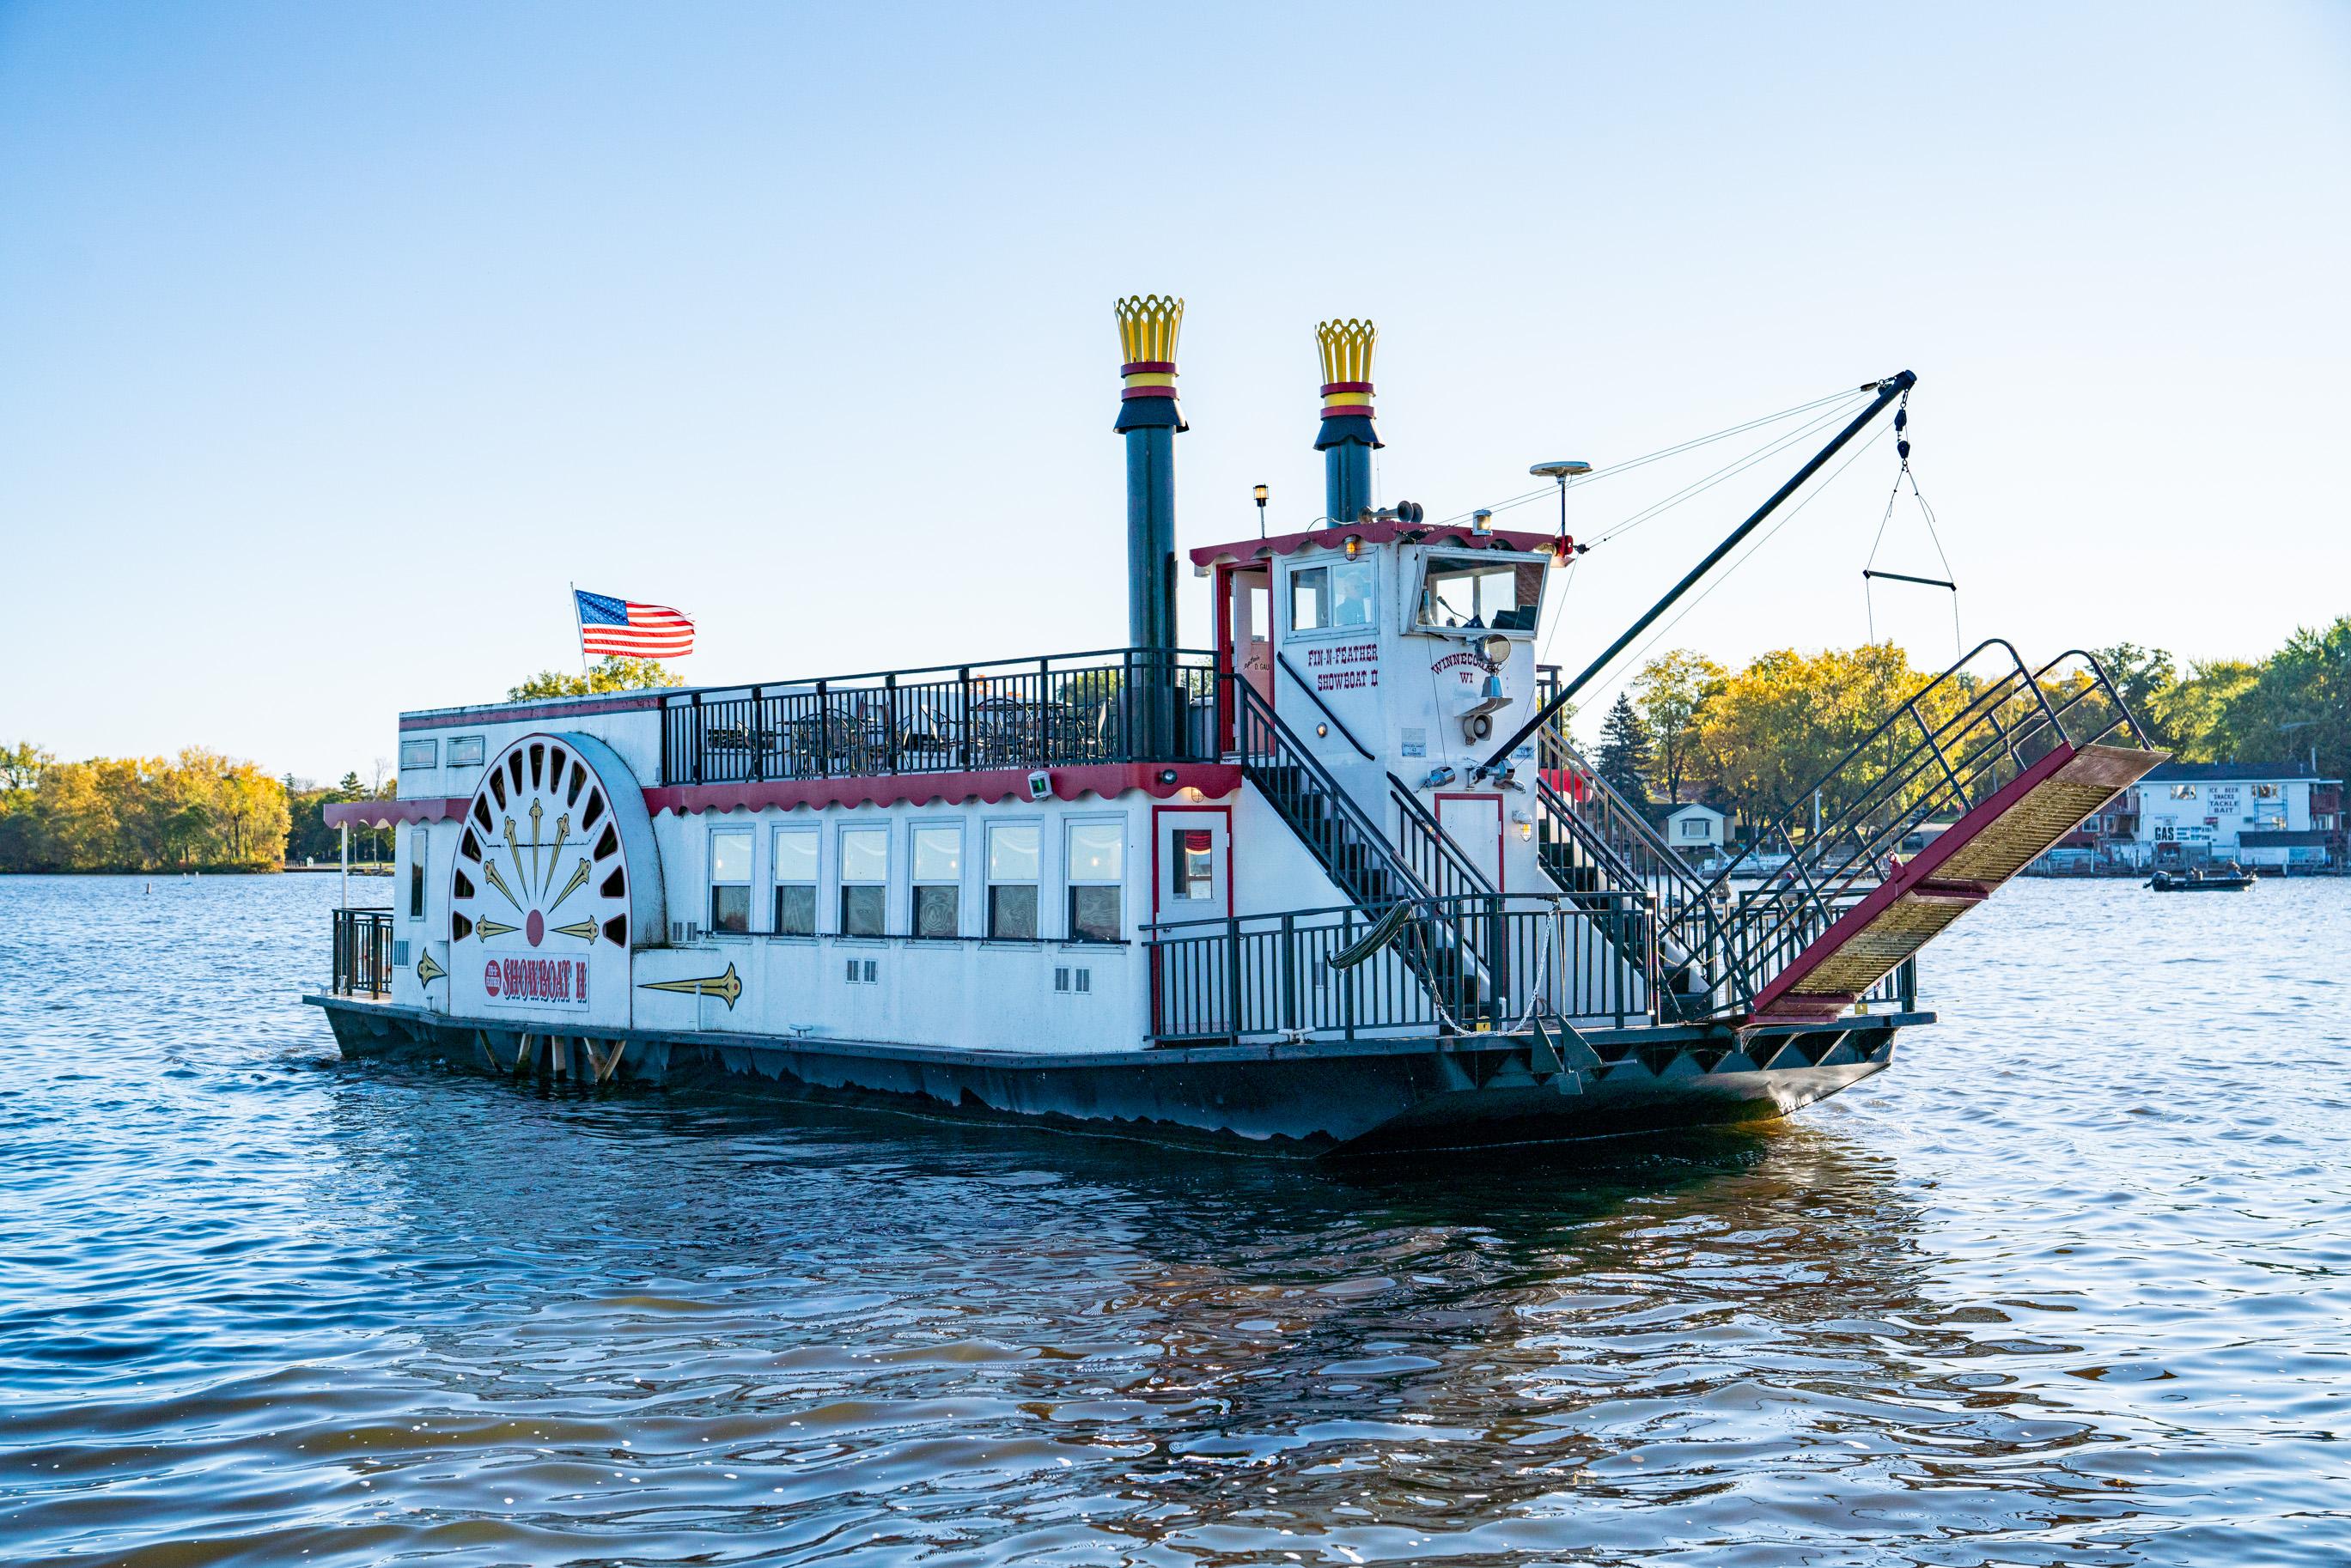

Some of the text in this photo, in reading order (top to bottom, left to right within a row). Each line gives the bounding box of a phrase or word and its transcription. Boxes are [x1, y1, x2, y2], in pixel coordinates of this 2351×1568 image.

[1307, 643, 1379, 667] FIN-N-FEATHER
[1317, 670, 1367, 692] SHOWBOAT
[1459, 672, 1473, 684] WI
[2154, 827, 2174, 841] GAS
[502, 957, 572, 1003] SHOWBOAT
